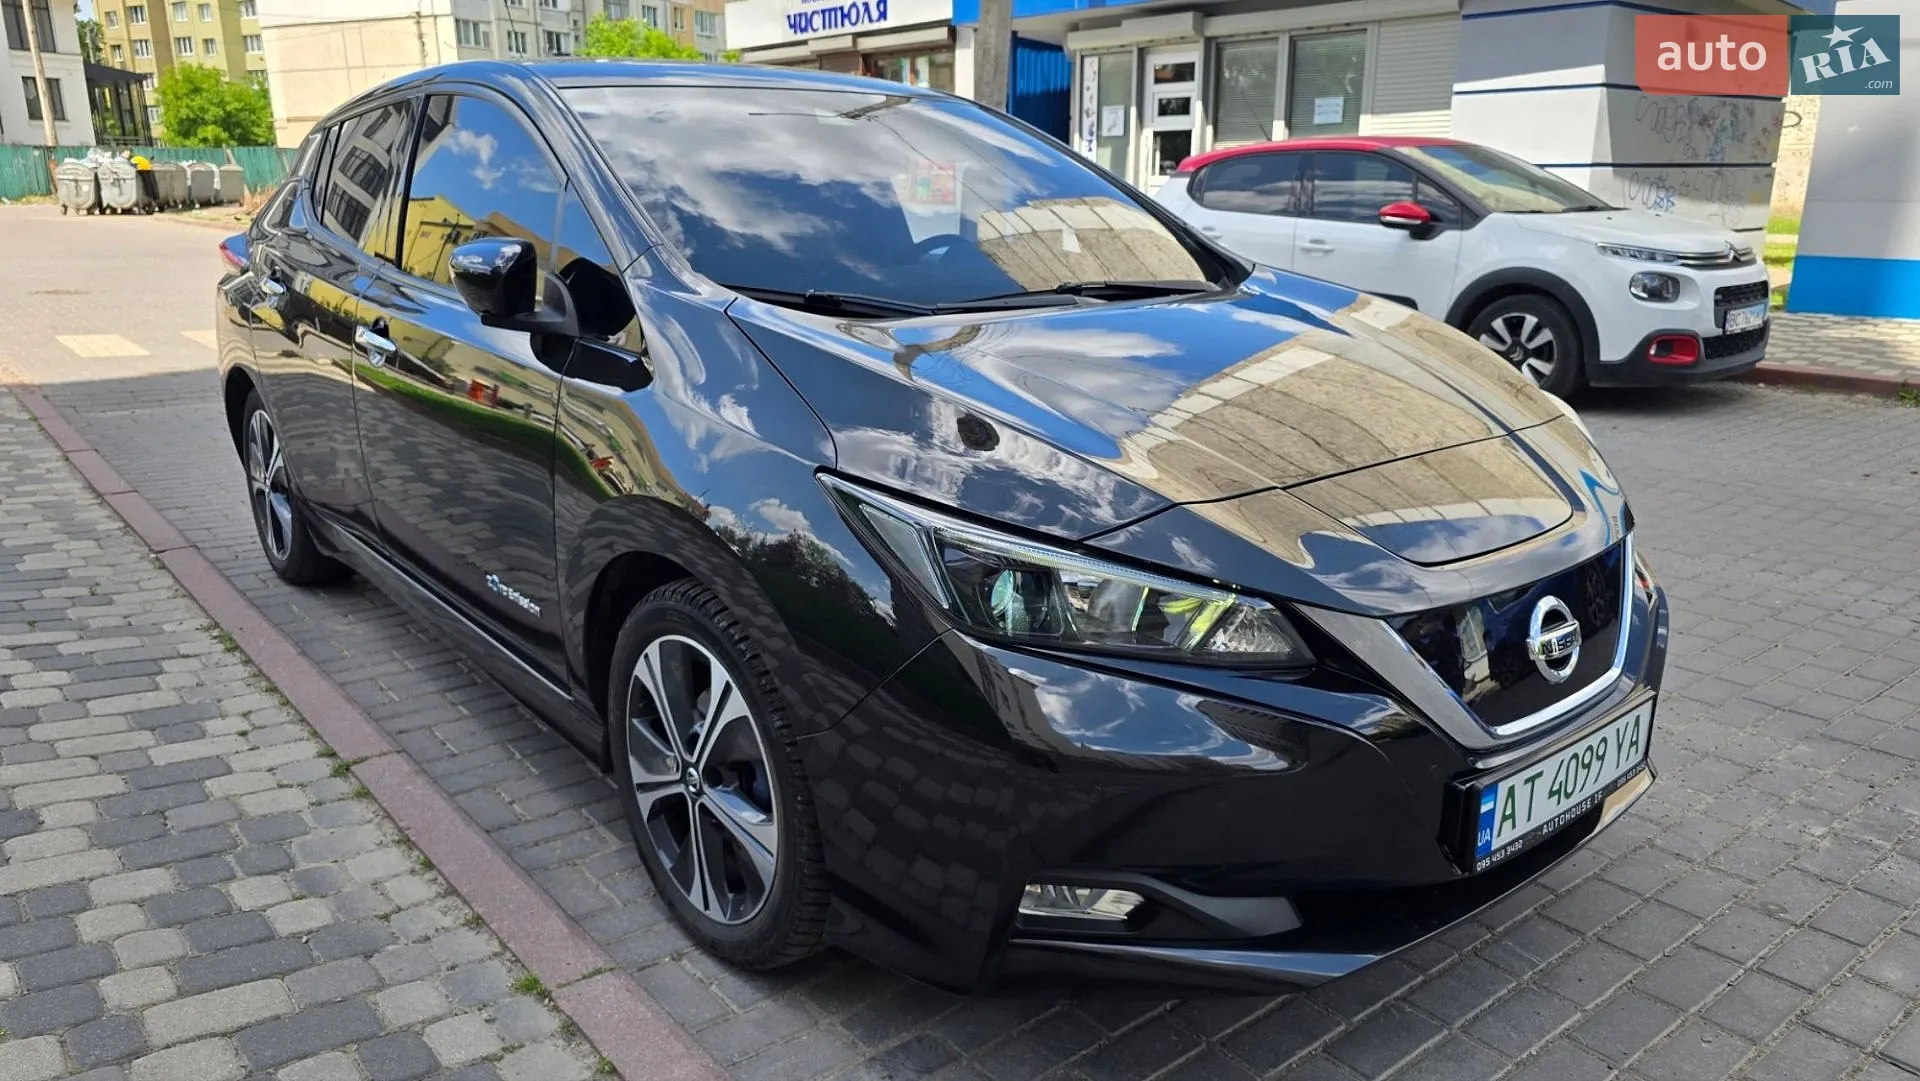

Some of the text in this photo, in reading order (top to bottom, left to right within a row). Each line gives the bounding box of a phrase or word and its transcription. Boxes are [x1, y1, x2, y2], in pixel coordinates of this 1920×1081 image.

[1496, 713, 1641, 838] AT 4099 YA
[1542, 798, 1592, 835] AUTOHOUSE
[1477, 828, 1491, 847] UA
[1476, 855, 1491, 872] 095
